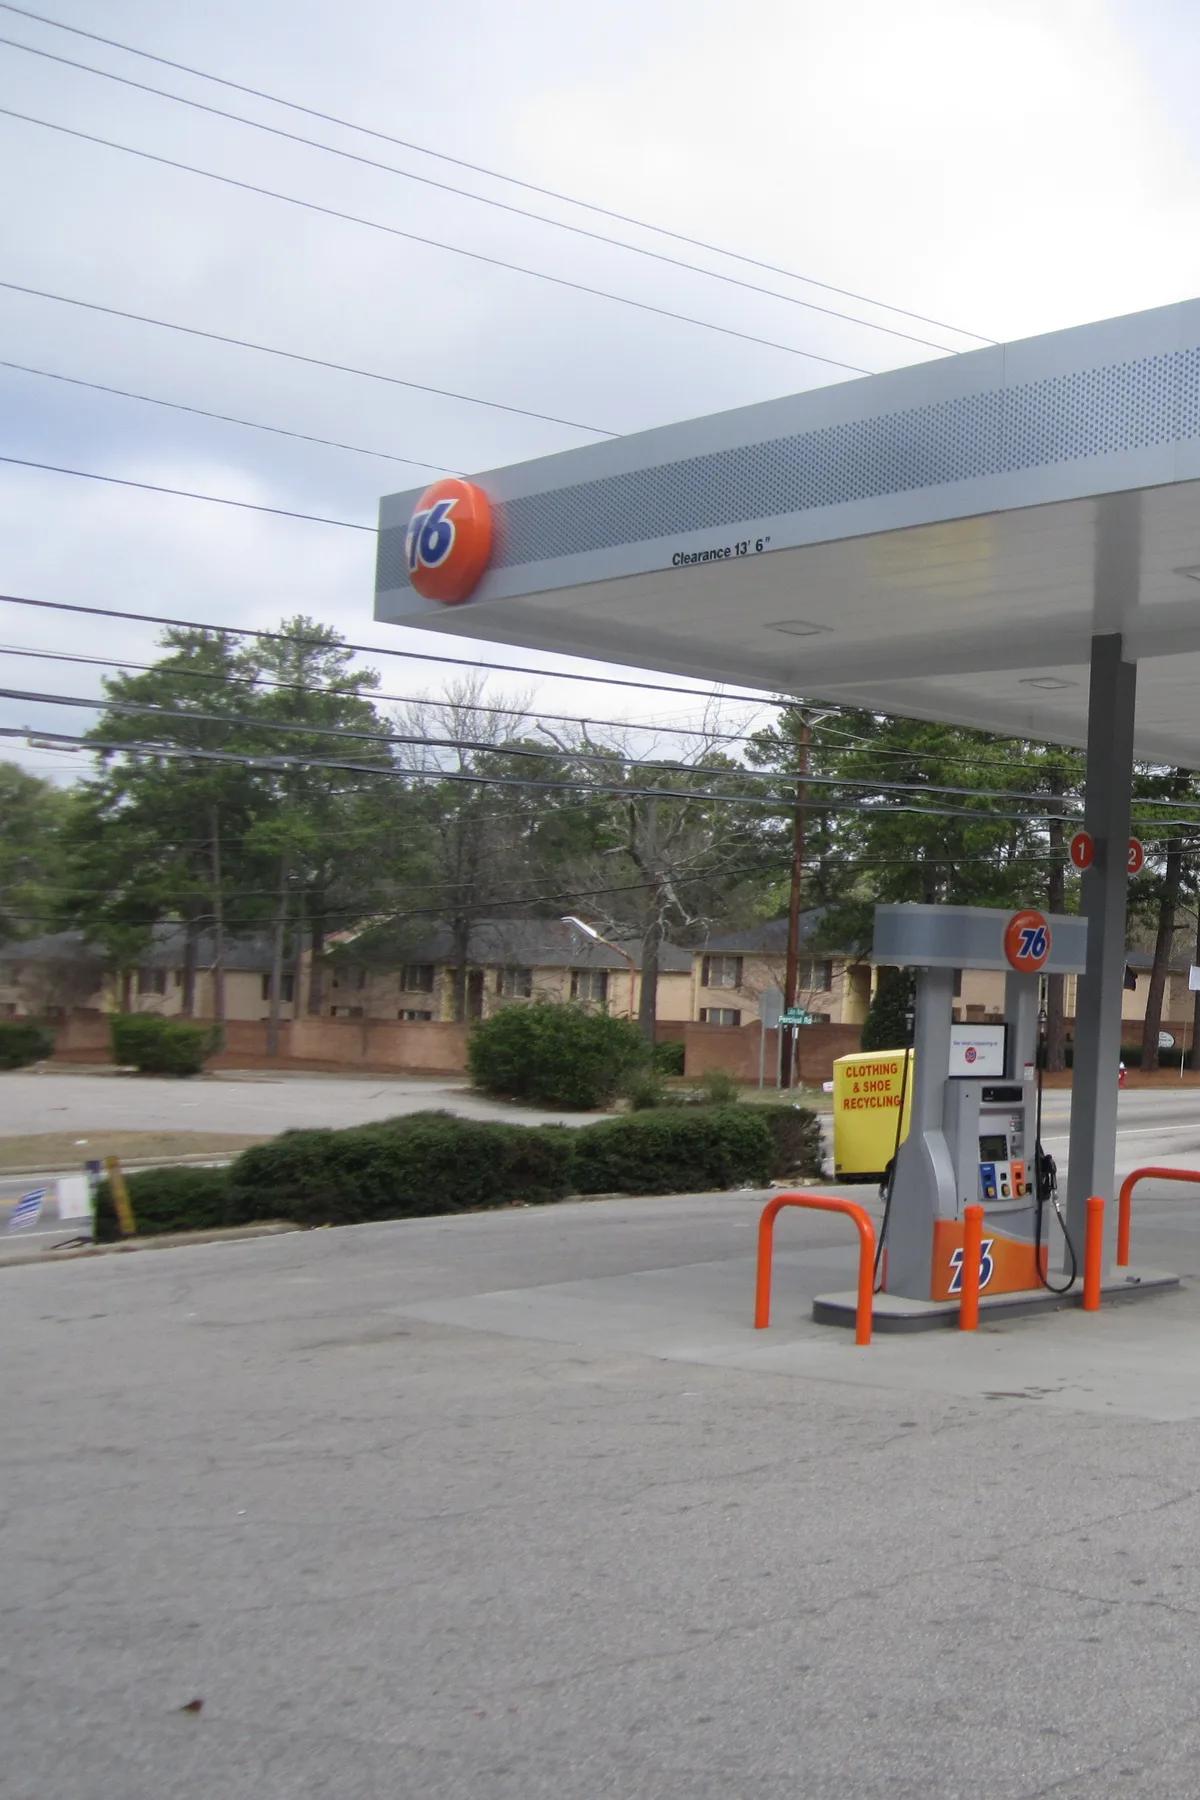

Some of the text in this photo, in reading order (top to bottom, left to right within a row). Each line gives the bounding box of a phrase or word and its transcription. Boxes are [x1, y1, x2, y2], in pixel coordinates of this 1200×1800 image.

[405, 499, 459, 573] 76
[672, 546, 731, 565] Clearance
[734, 540, 751, 556] 13'
[1079, 843, 1085, 861] 1
[1127, 848, 1137, 866] 2
[1016, 926, 1047, 960] 76
[846, 1063, 898, 1078] CLOTHING
[853, 1080, 891, 1093] & SHOE
[843, 1095, 901, 1110] RECYCLING
